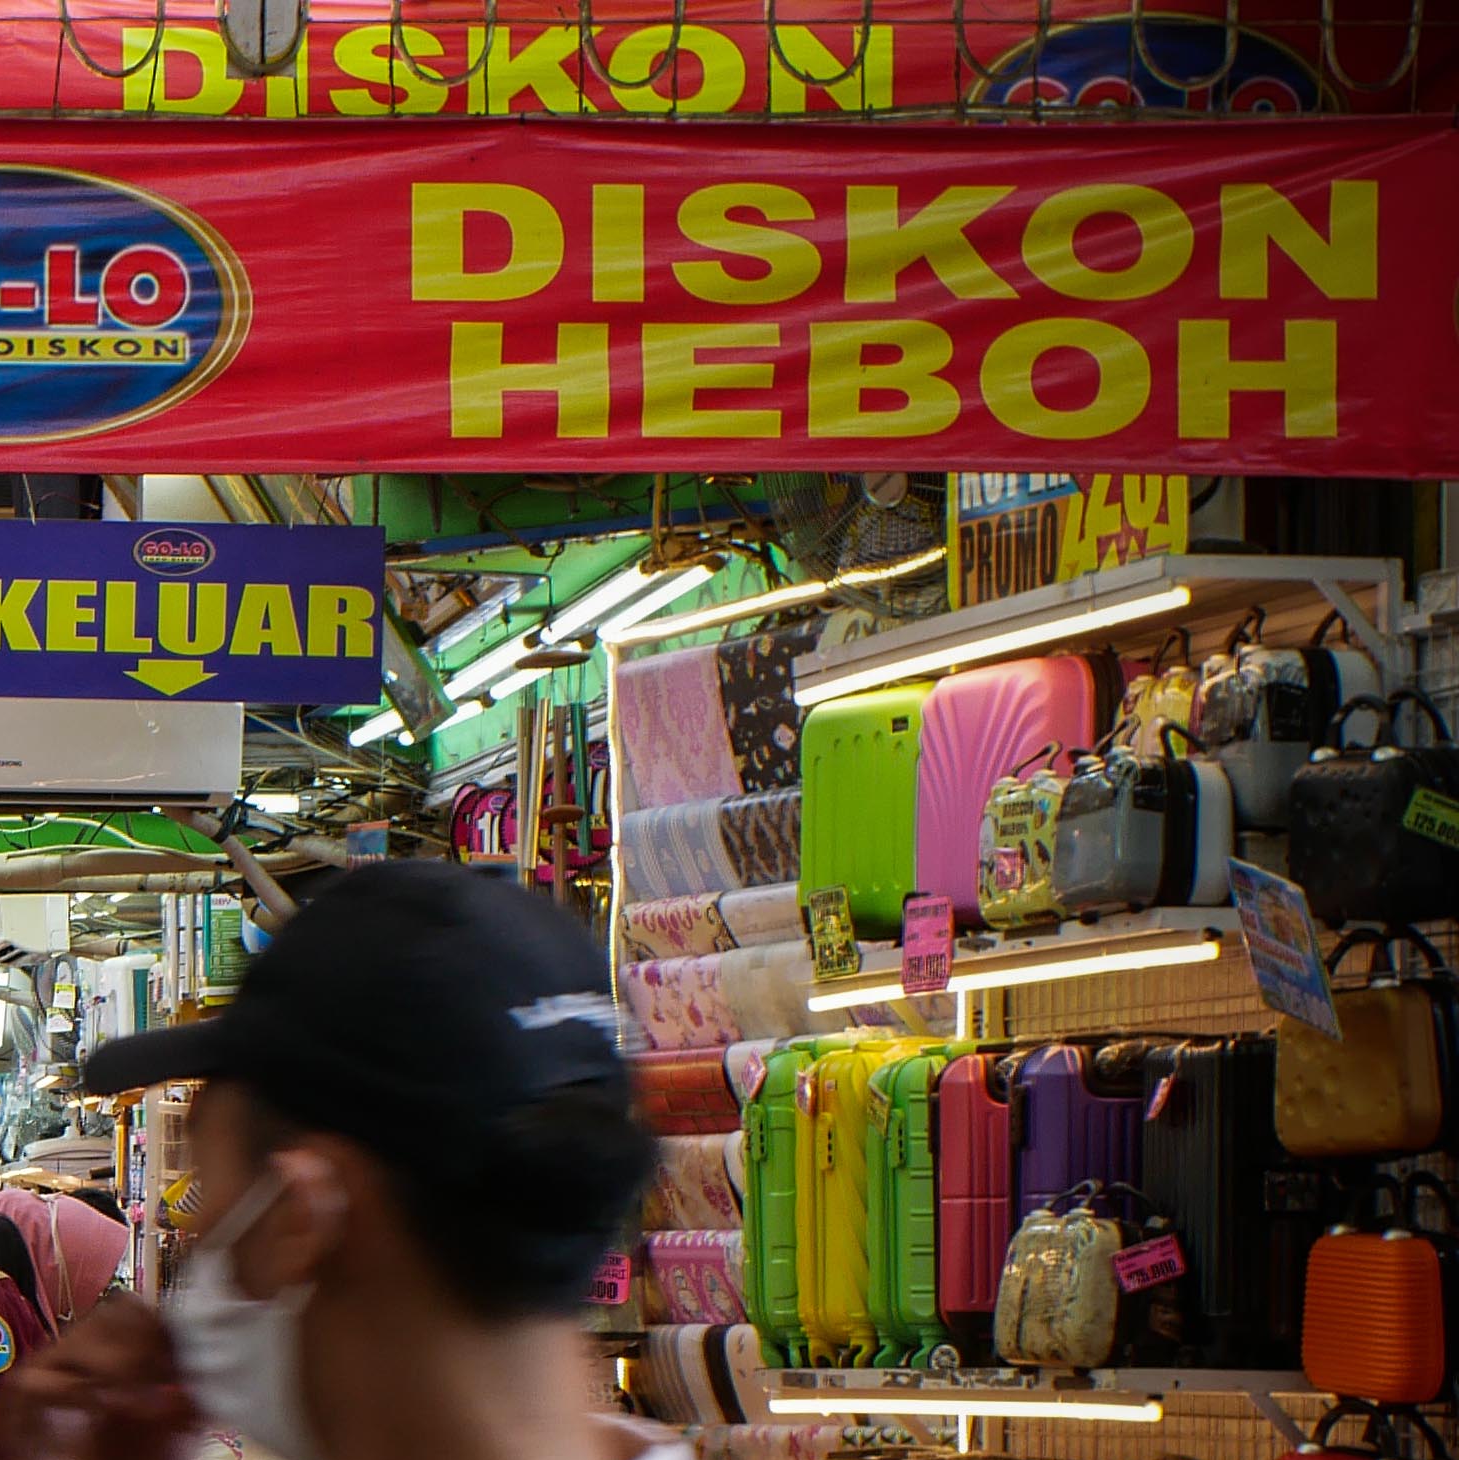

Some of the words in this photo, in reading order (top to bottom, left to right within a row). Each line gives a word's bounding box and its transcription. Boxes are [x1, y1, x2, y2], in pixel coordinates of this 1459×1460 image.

[411, 180, 1379, 306] DISKON
[449, 317, 1339, 440] HEBOH
[142, 540, 207, 557] GO-LO
[960, 501, 1059, 608] PROMO
